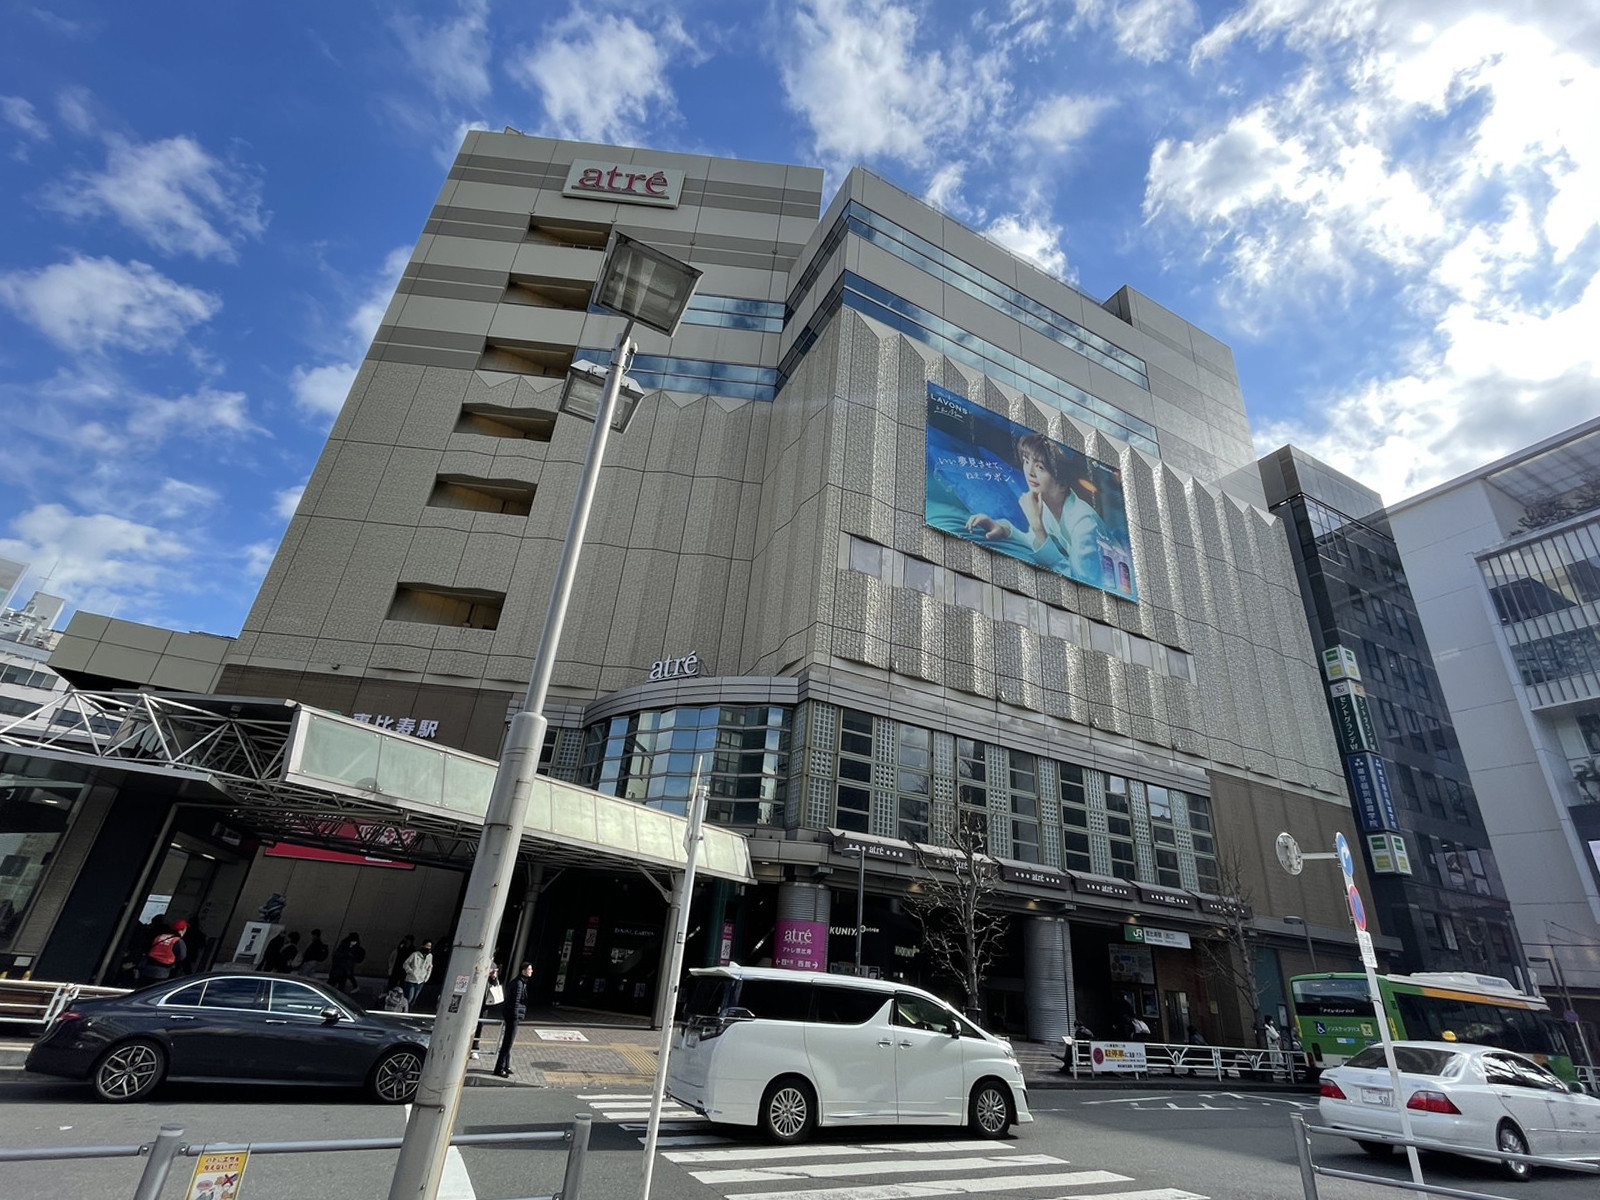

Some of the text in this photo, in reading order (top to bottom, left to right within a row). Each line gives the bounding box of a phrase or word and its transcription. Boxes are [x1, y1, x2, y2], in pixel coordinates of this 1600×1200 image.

[577, 165, 669, 196] atré
[930, 393, 968, 415] LAVONS
[649, 650, 698, 680] atré
[868, 846, 884, 856] atré
[784, 928, 813, 943] atré
[1133, 928, 1143, 937] JR
